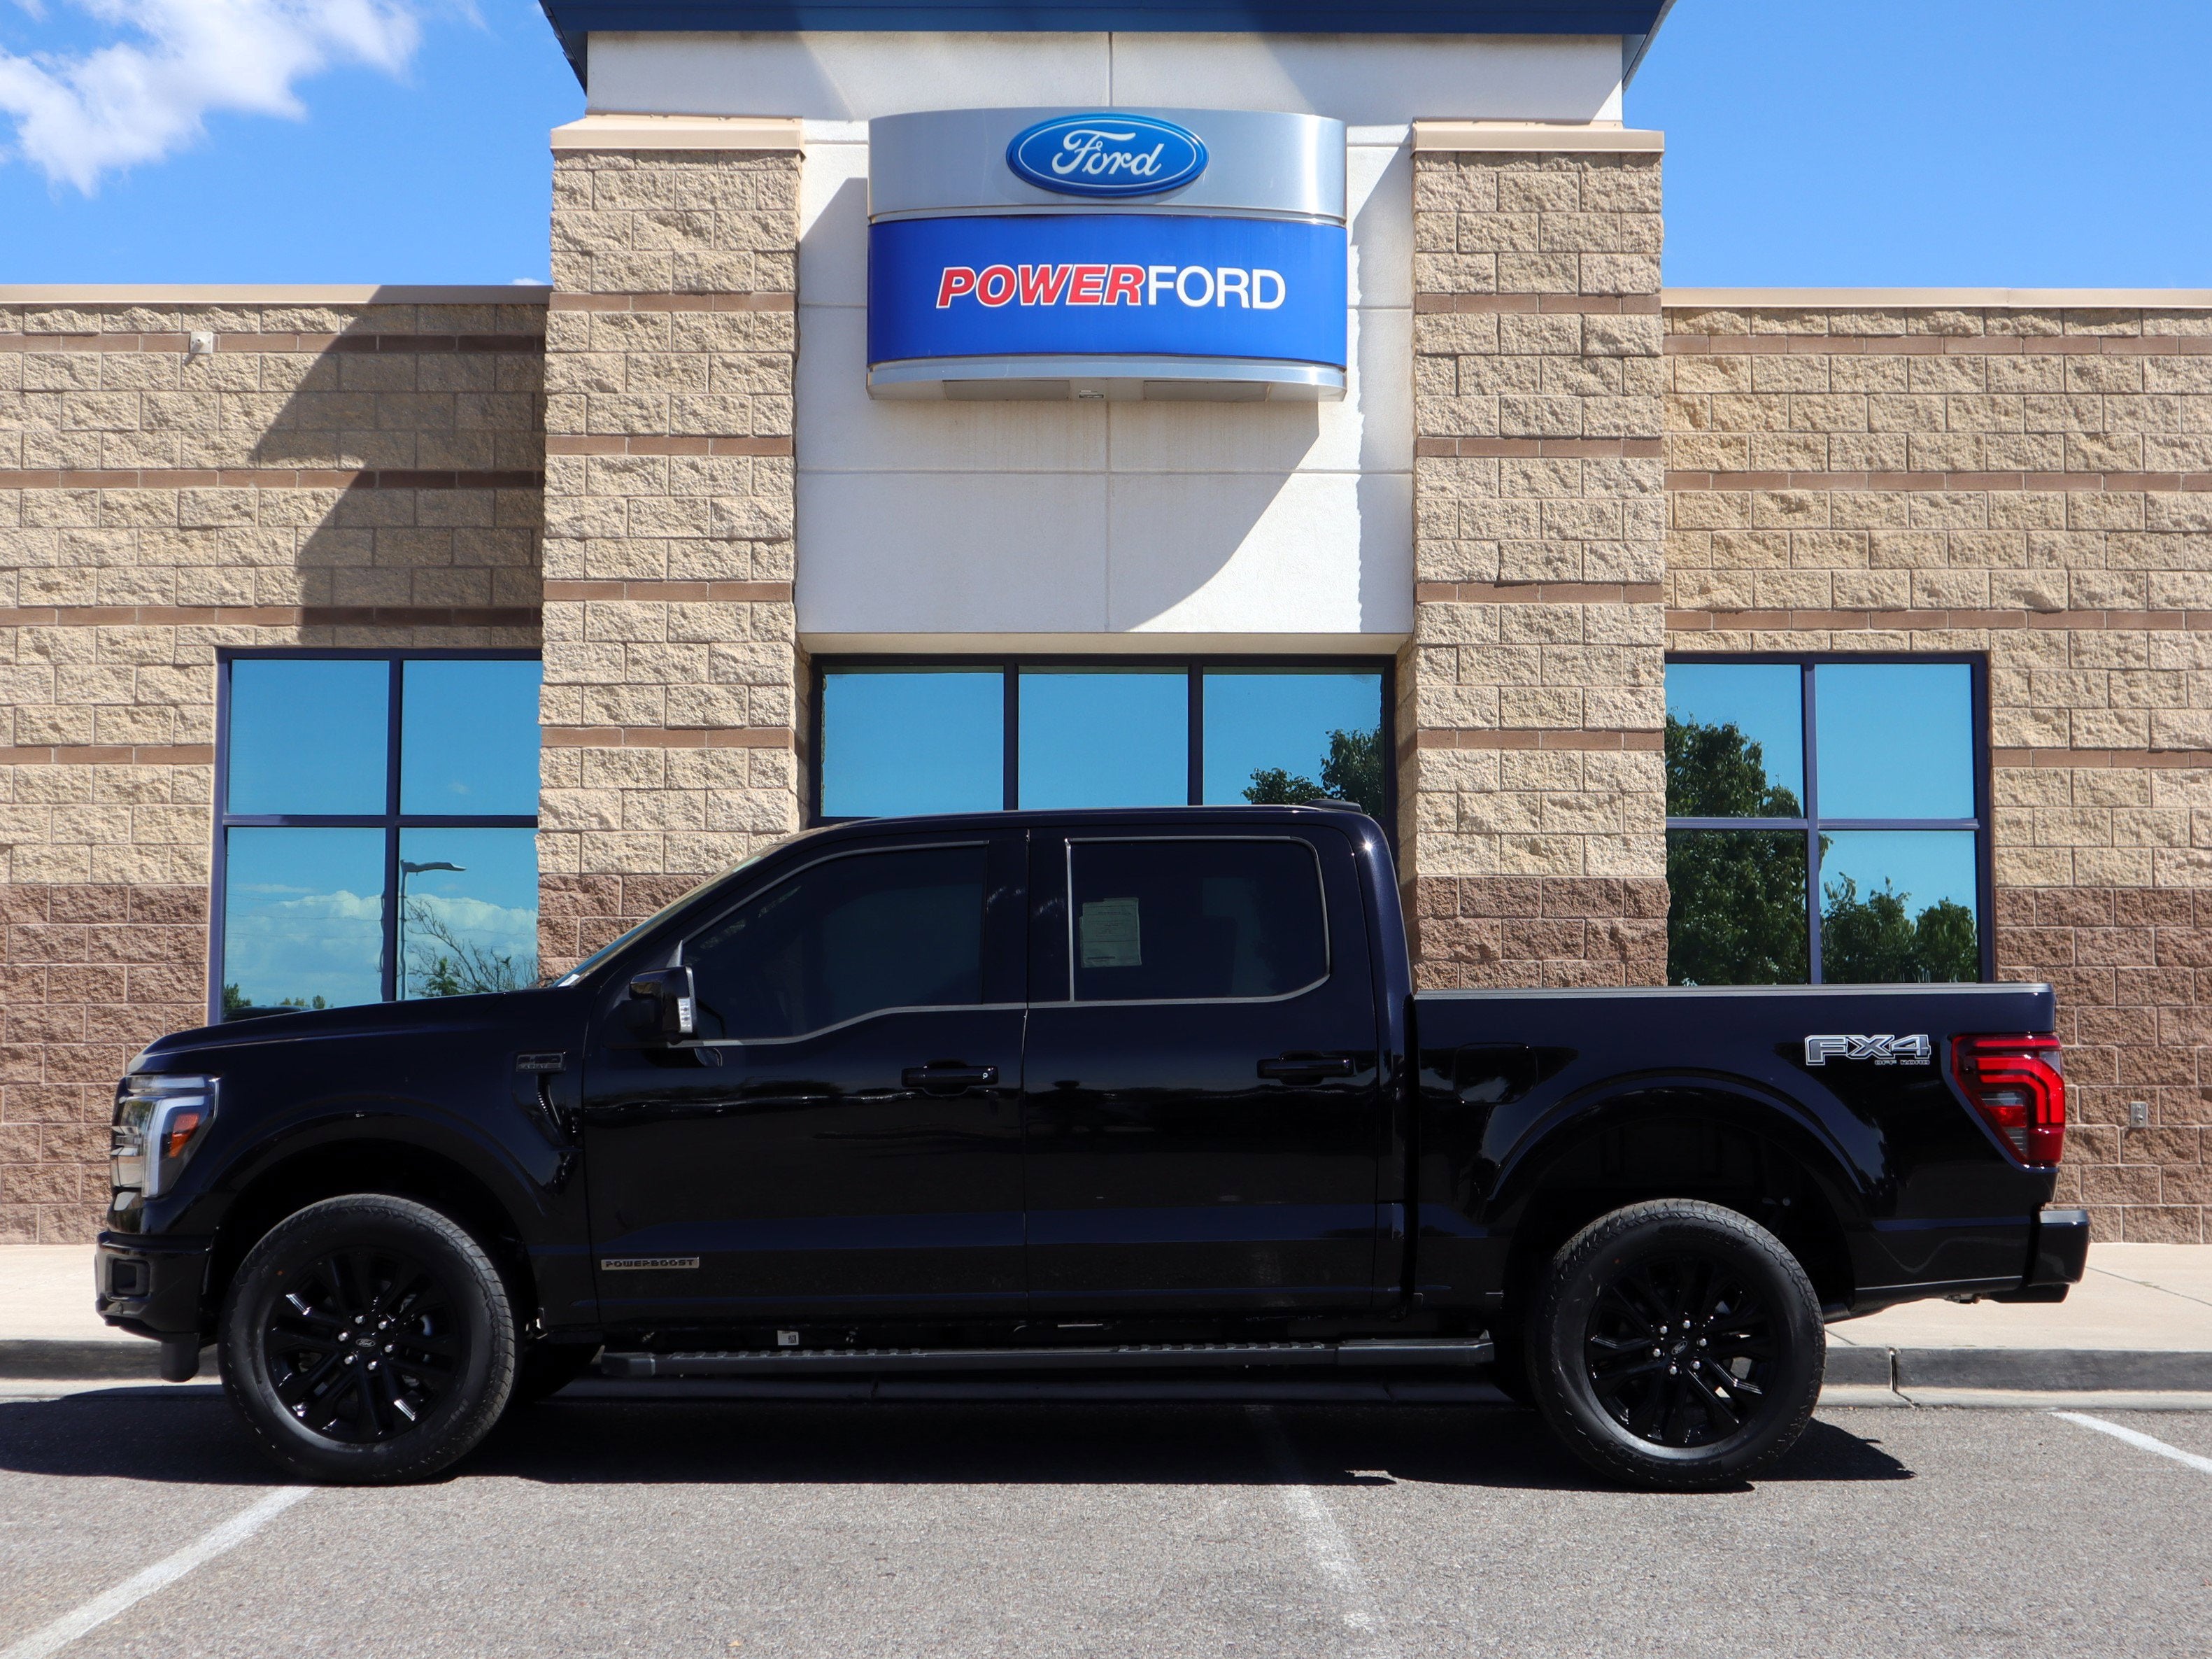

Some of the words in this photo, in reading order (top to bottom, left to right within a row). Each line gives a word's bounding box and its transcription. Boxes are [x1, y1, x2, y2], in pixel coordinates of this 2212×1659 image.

[1051, 129, 1165, 176] Ford
[936, 264, 1286, 309] POWERFORD
[1805, 1035, 1931, 1065] FX4
